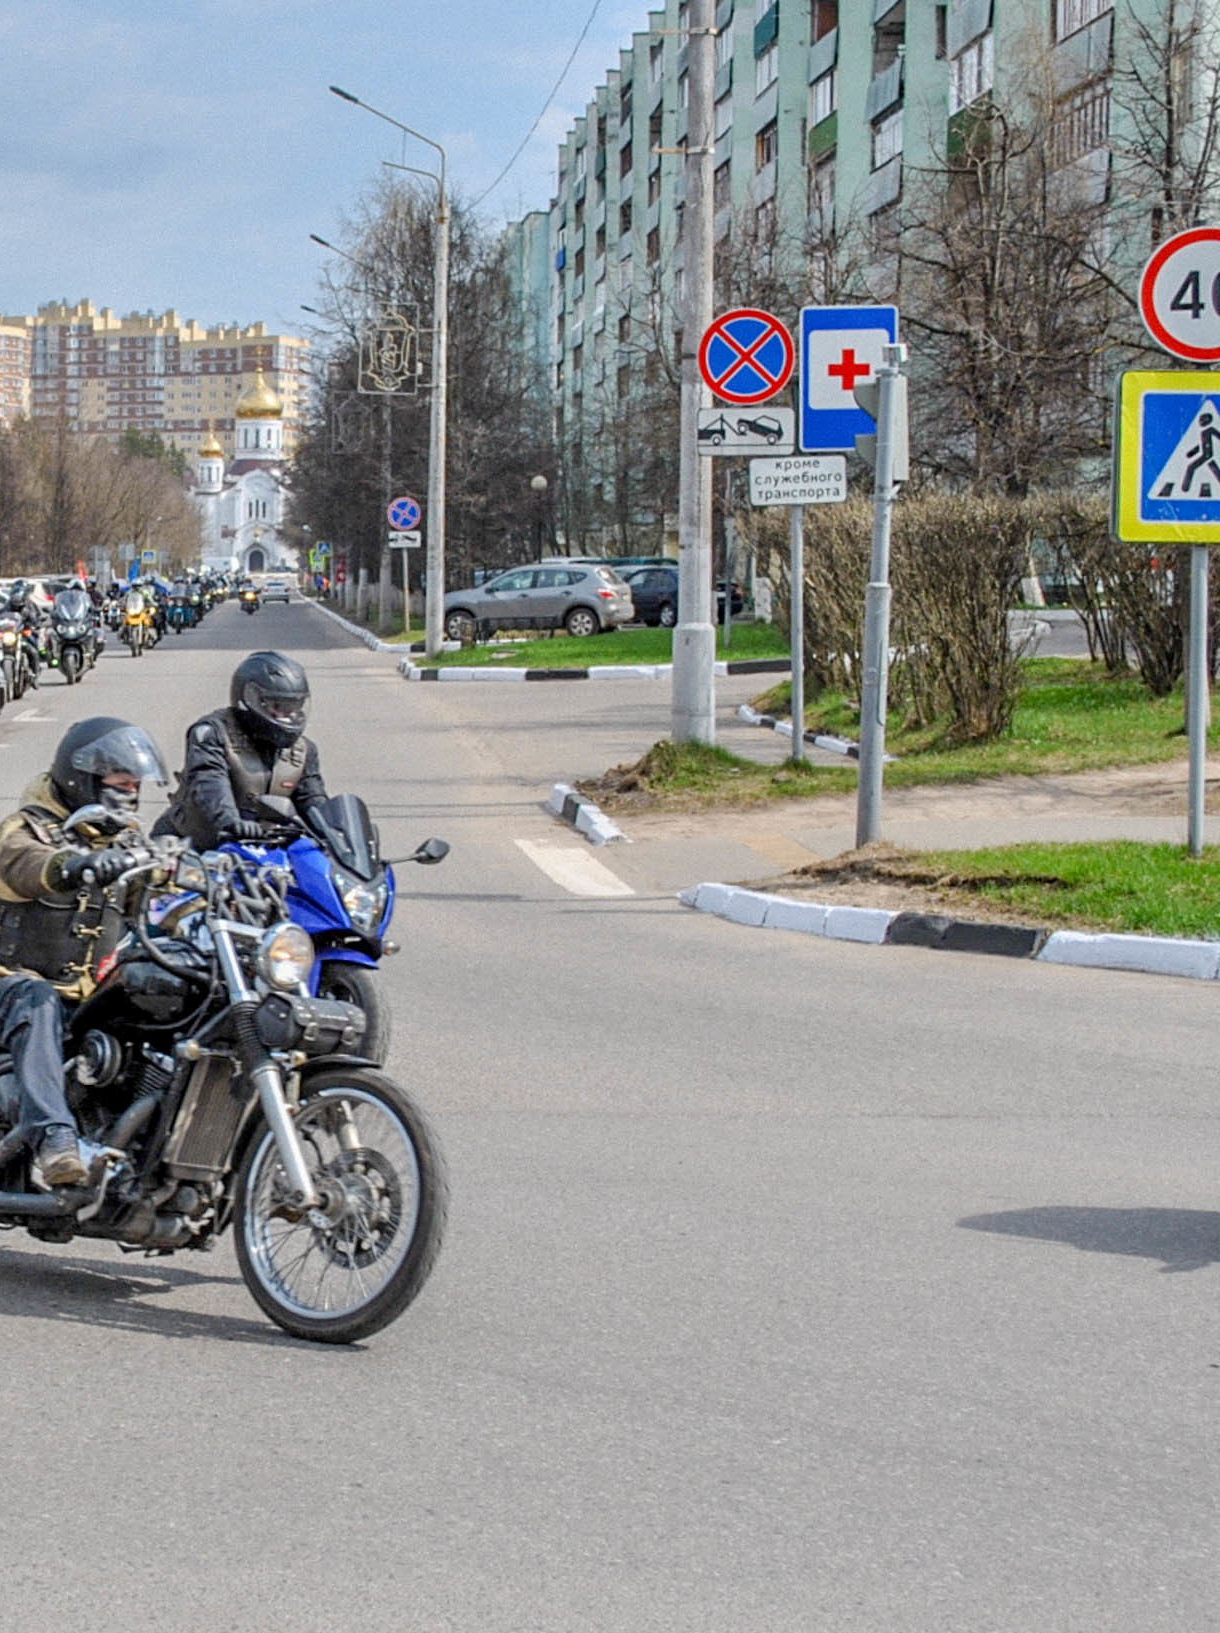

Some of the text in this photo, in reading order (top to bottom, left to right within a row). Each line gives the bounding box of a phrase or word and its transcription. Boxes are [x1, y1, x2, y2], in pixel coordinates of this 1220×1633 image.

[1170, 270, 1220, 319] 4
[775, 459, 820, 471] кроме
[754, 472, 843, 487] служебного
[757, 487, 840, 501] транспорта
